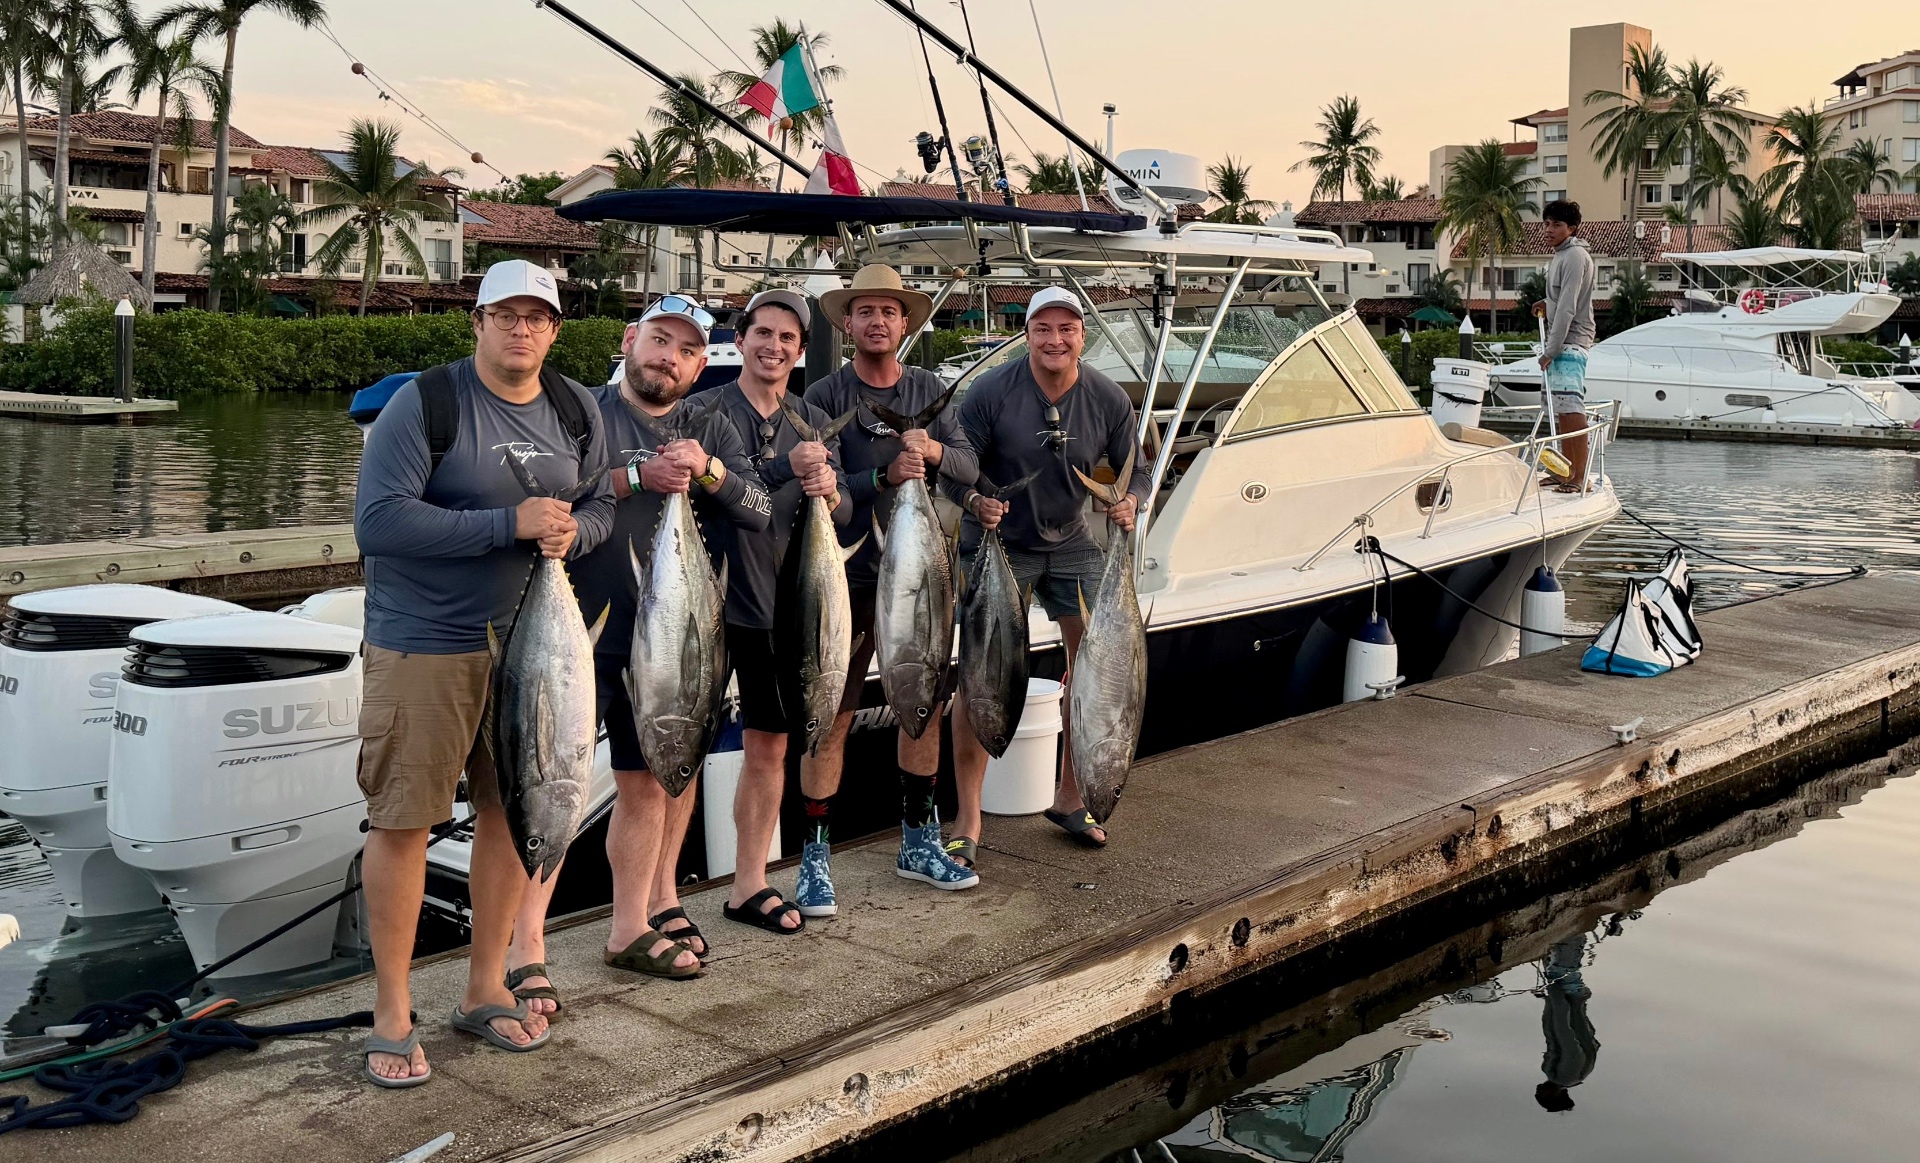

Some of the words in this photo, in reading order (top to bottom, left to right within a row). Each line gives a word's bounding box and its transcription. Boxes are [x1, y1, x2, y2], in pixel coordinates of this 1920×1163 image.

[1123, 168, 1161, 180] MIN
[1452, 368, 1469, 376] YETI
[0, 673, 19, 696] 00
[82, 716, 113, 725] FOU
[112, 709, 148, 737] 300
[222, 696, 359, 739] SUZU
[218, 755, 260, 768] FOUR
[260, 752, 301, 762] STROKE
